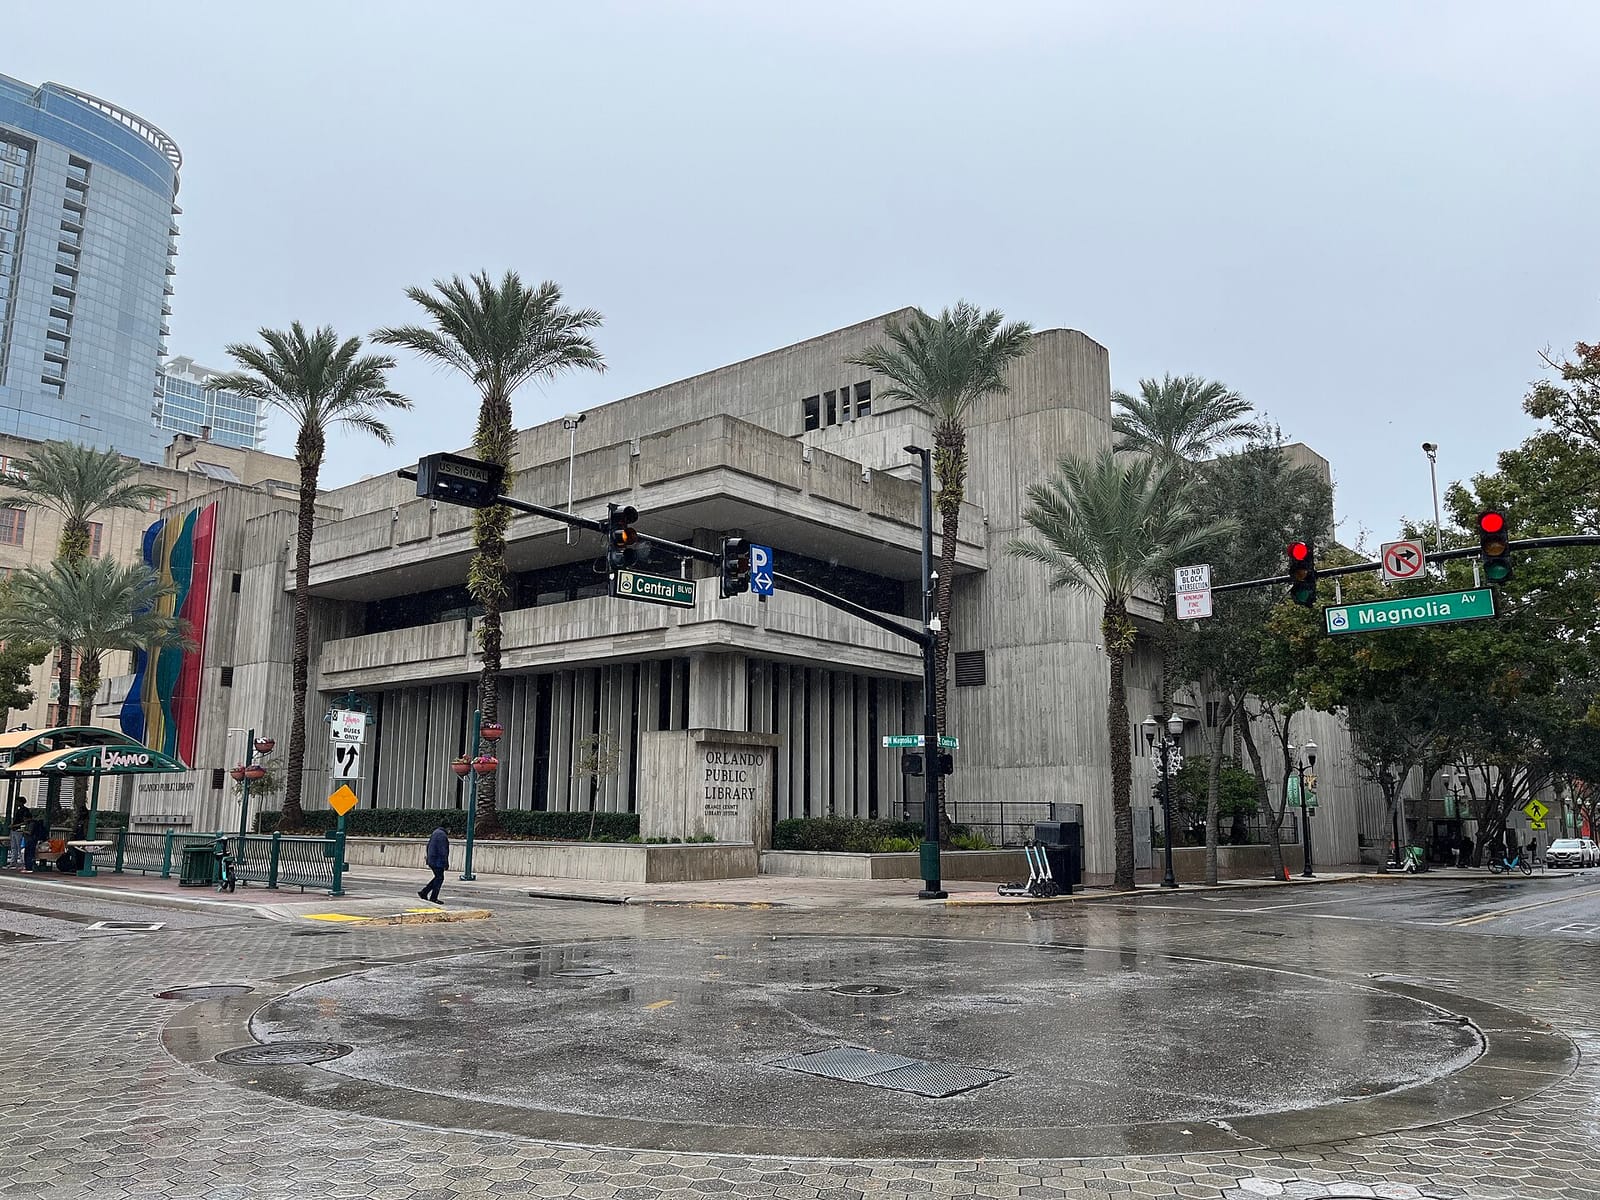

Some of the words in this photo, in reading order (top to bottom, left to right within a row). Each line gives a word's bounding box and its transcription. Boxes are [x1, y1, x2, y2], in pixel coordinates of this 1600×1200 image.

[440, 462, 451, 473] US
[454, 466, 488, 480] SIGNAL
[752, 547, 767, 574] P
[1192, 568, 1204, 576] NOT
[1179, 582, 1208, 591] NTERSECTION
[1182, 575, 1203, 584] BLOCK
[636, 578, 675, 597] Central
[677, 585, 692, 594] BLVD
[1358, 602, 1450, 624] Magnolia
[1461, 594, 1476, 604] Av
[343, 727, 360, 735] BUSES
[101, 746, 149, 770] LYMMO
[706, 751, 763, 766] ORLANDO
[705, 769, 747, 782] PUBLIC
[705, 787, 756, 800] LIBRARY
